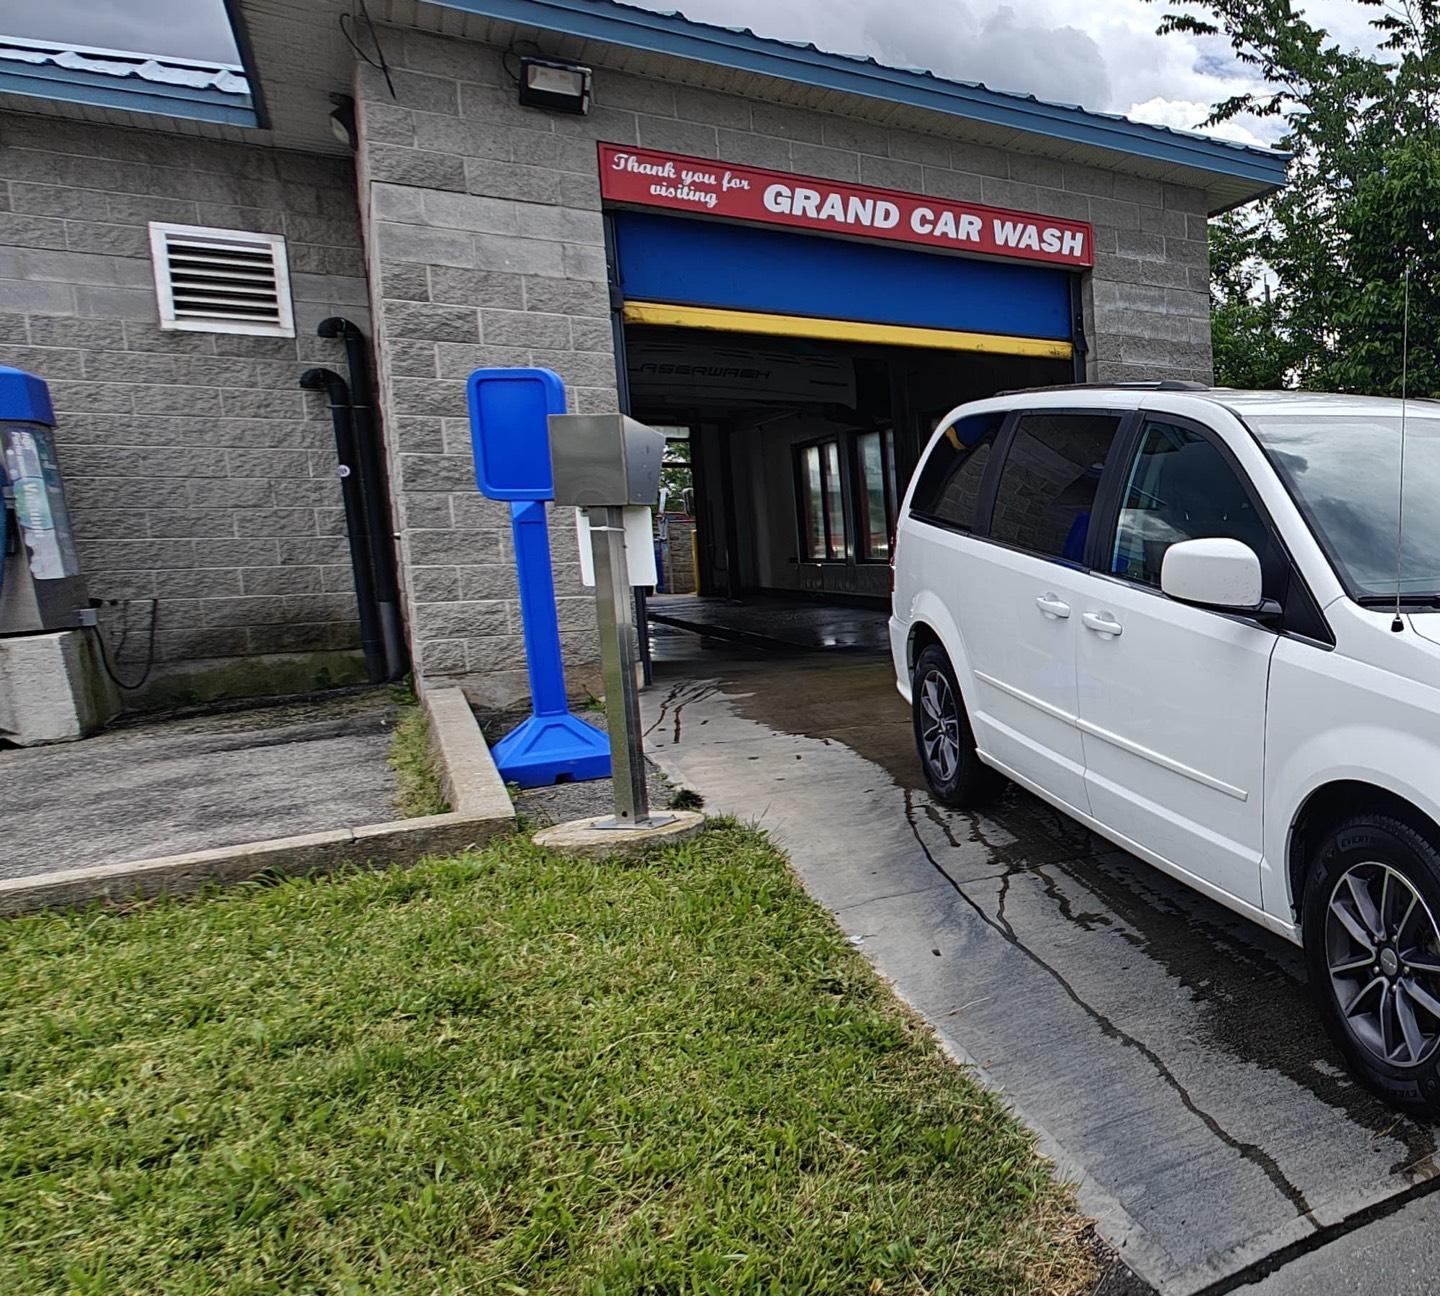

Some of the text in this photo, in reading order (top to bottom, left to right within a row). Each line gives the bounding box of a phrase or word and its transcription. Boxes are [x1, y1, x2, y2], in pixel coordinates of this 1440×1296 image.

[612, 153, 750, 192] Thank you for
[650, 182, 718, 208] visiting
[763, 184, 1084, 257] GRAND CAR WASH
